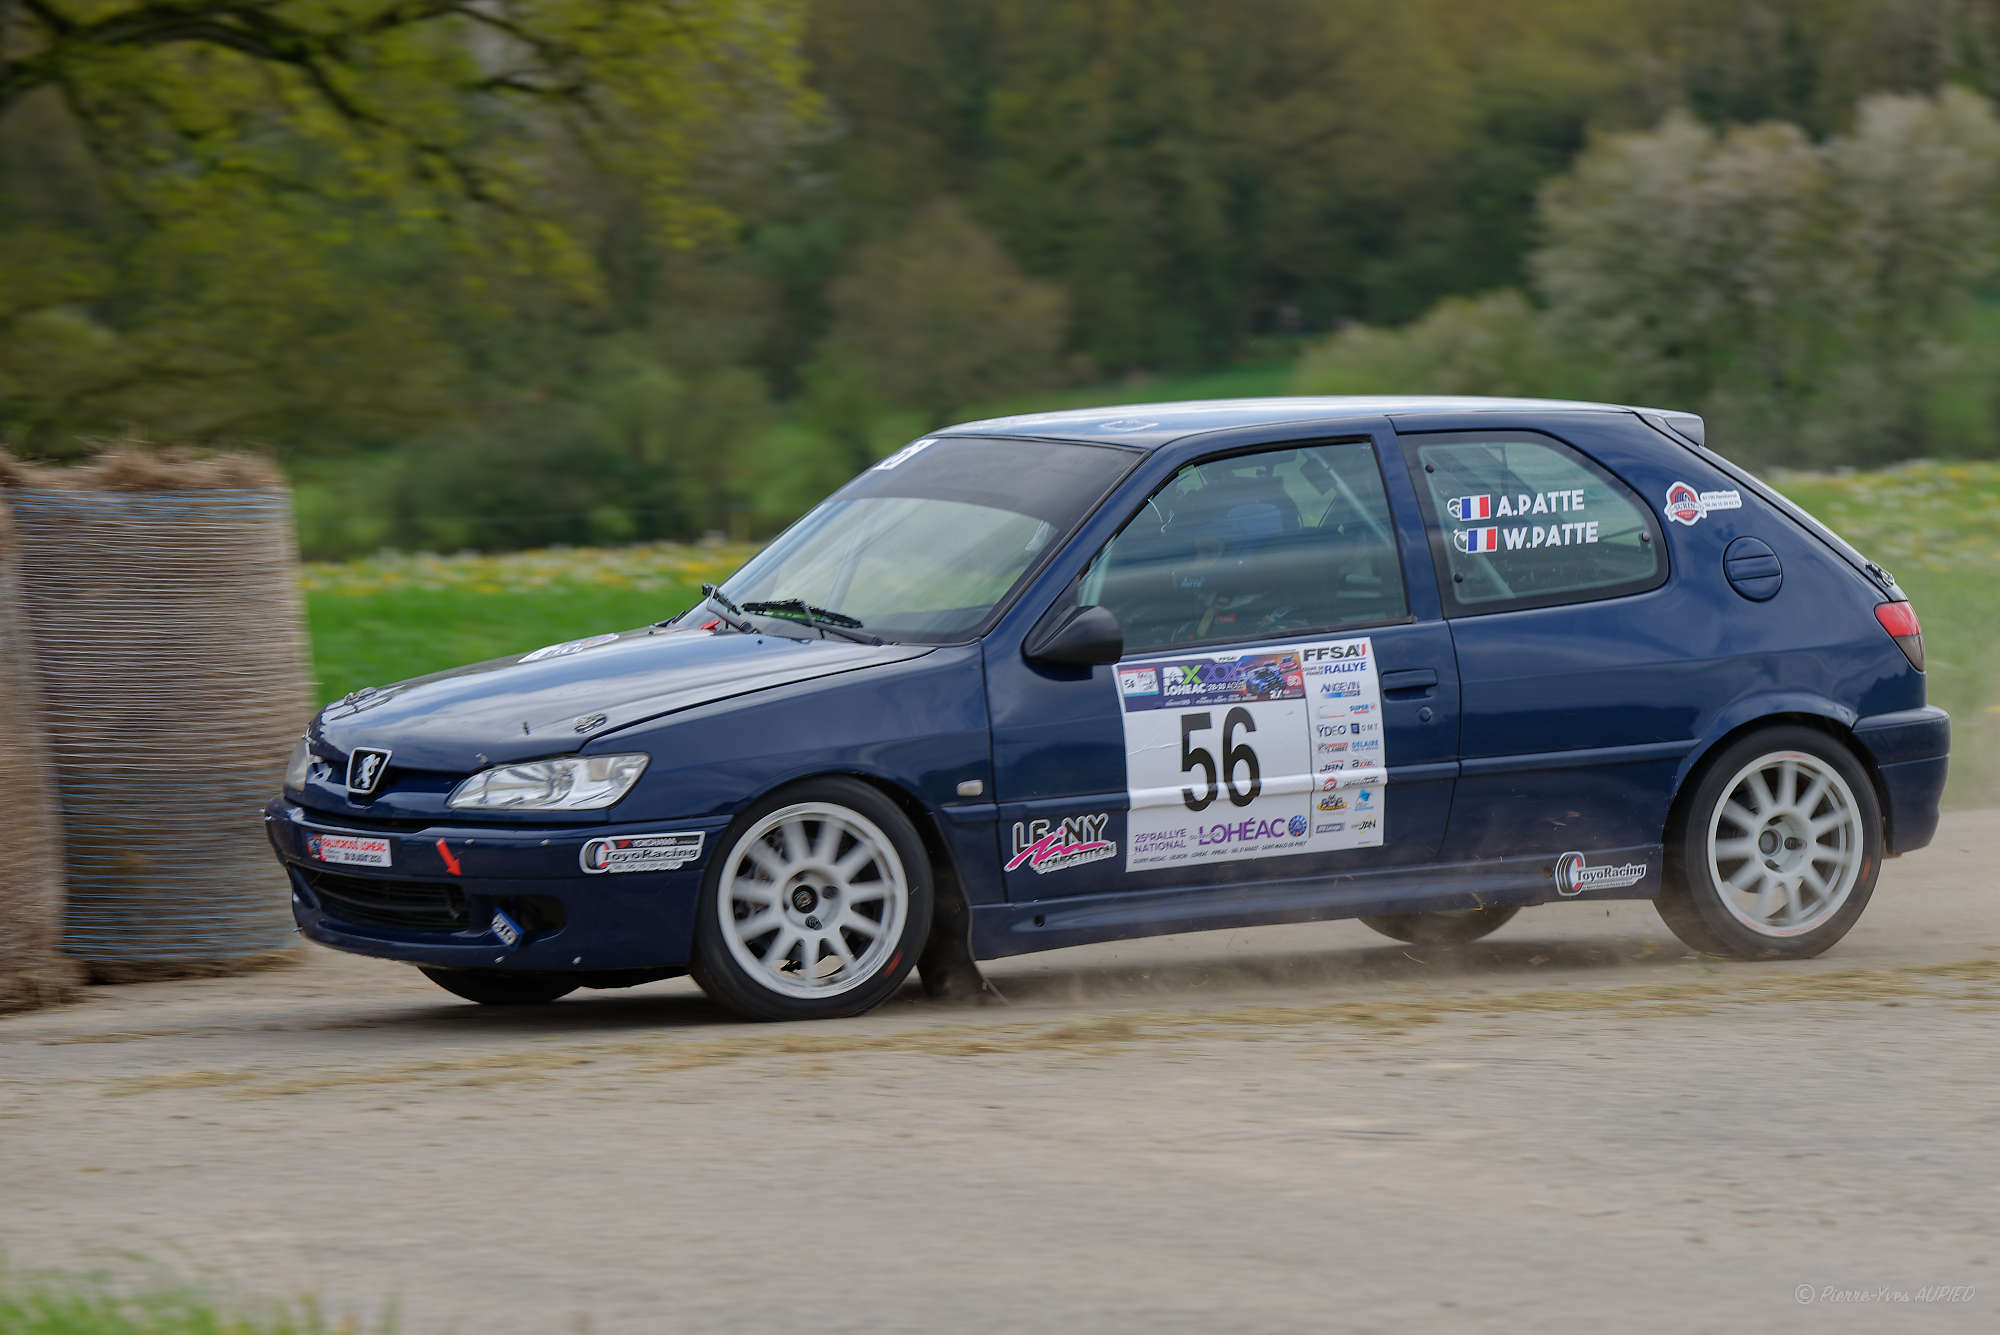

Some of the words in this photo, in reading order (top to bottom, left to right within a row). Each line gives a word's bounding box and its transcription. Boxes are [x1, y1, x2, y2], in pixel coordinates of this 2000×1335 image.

[1497, 489, 1585, 518] A.PATTE
[1503, 521, 1599, 550] W.PATTE
[1303, 645, 1360, 662] FFSA
[1325, 662, 1367, 675] RALLYE
[1181, 706, 1261, 811] 56
[1199, 817, 1285, 845] LOHÉAC
[1577, 864, 1645, 883] ToyoRacing
